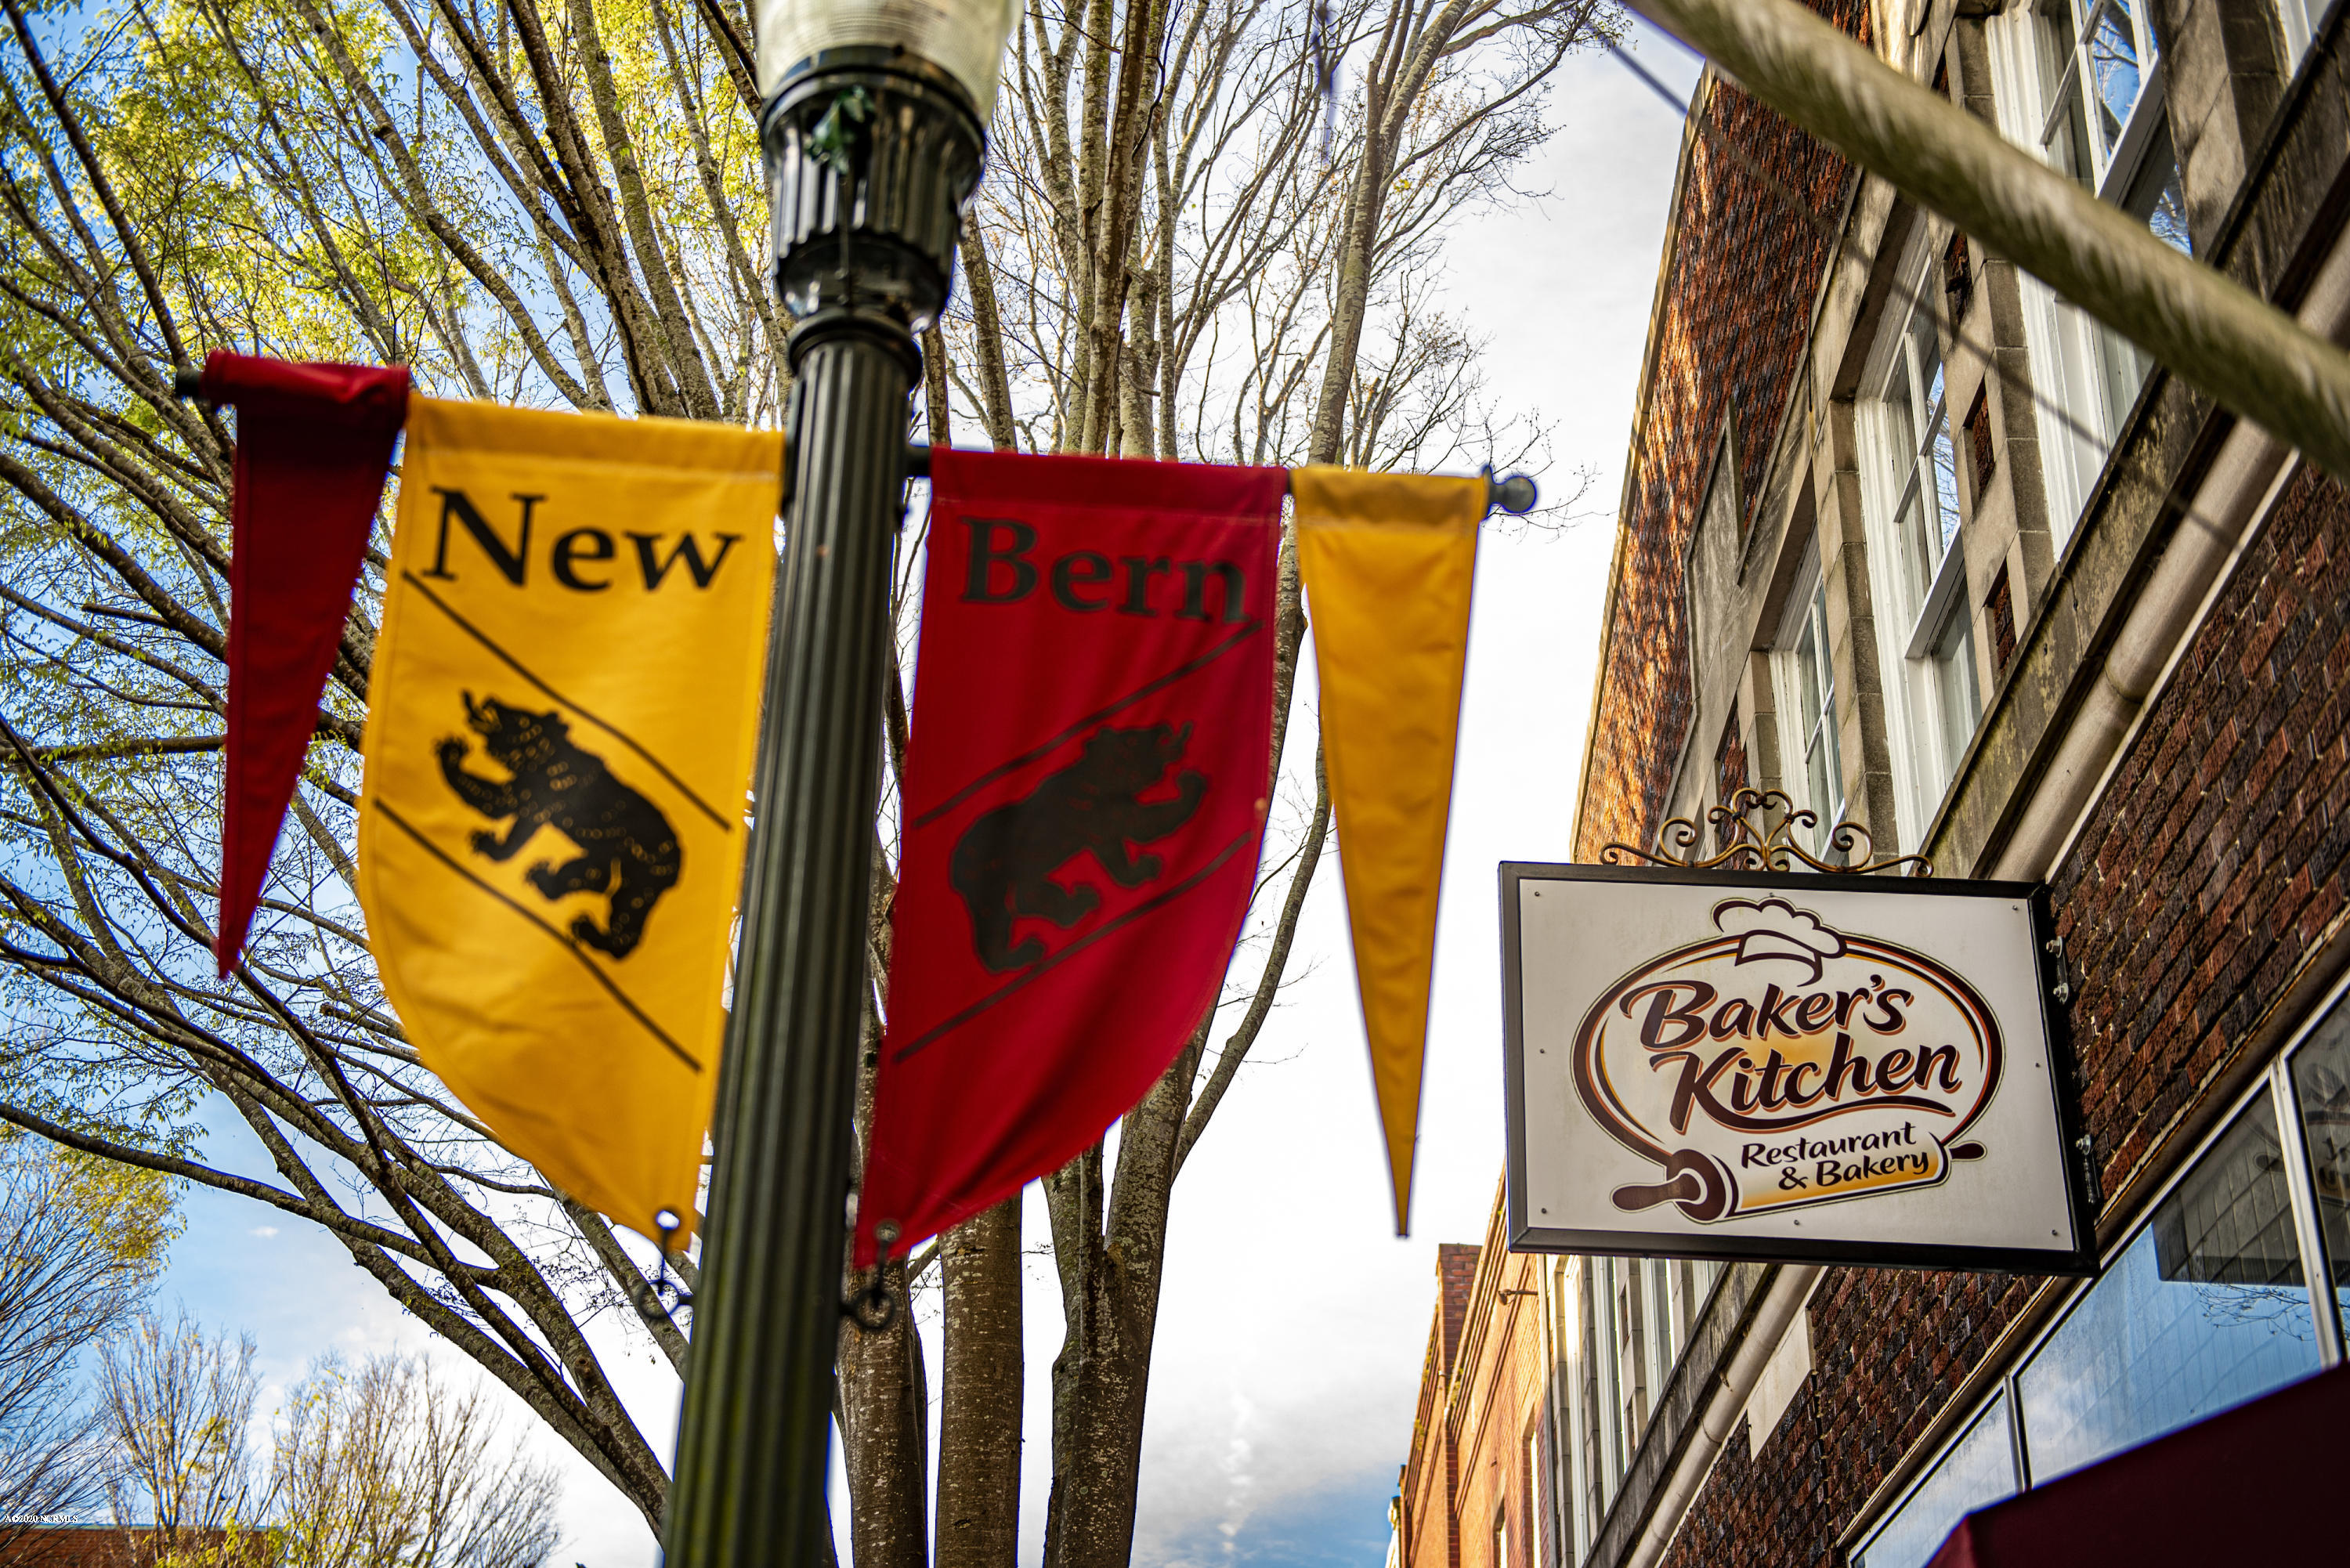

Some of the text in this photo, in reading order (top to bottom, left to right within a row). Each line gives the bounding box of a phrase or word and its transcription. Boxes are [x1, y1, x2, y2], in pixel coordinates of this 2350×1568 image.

[421, 484, 746, 593] New
[958, 515, 1252, 624] Bern
[1619, 974, 1914, 1053] Baker's
[1649, 1031, 1963, 1136] Kitchen
[1741, 1121, 1917, 1169] Restaurant
[1777, 1151, 1929, 1191] & Bakery
